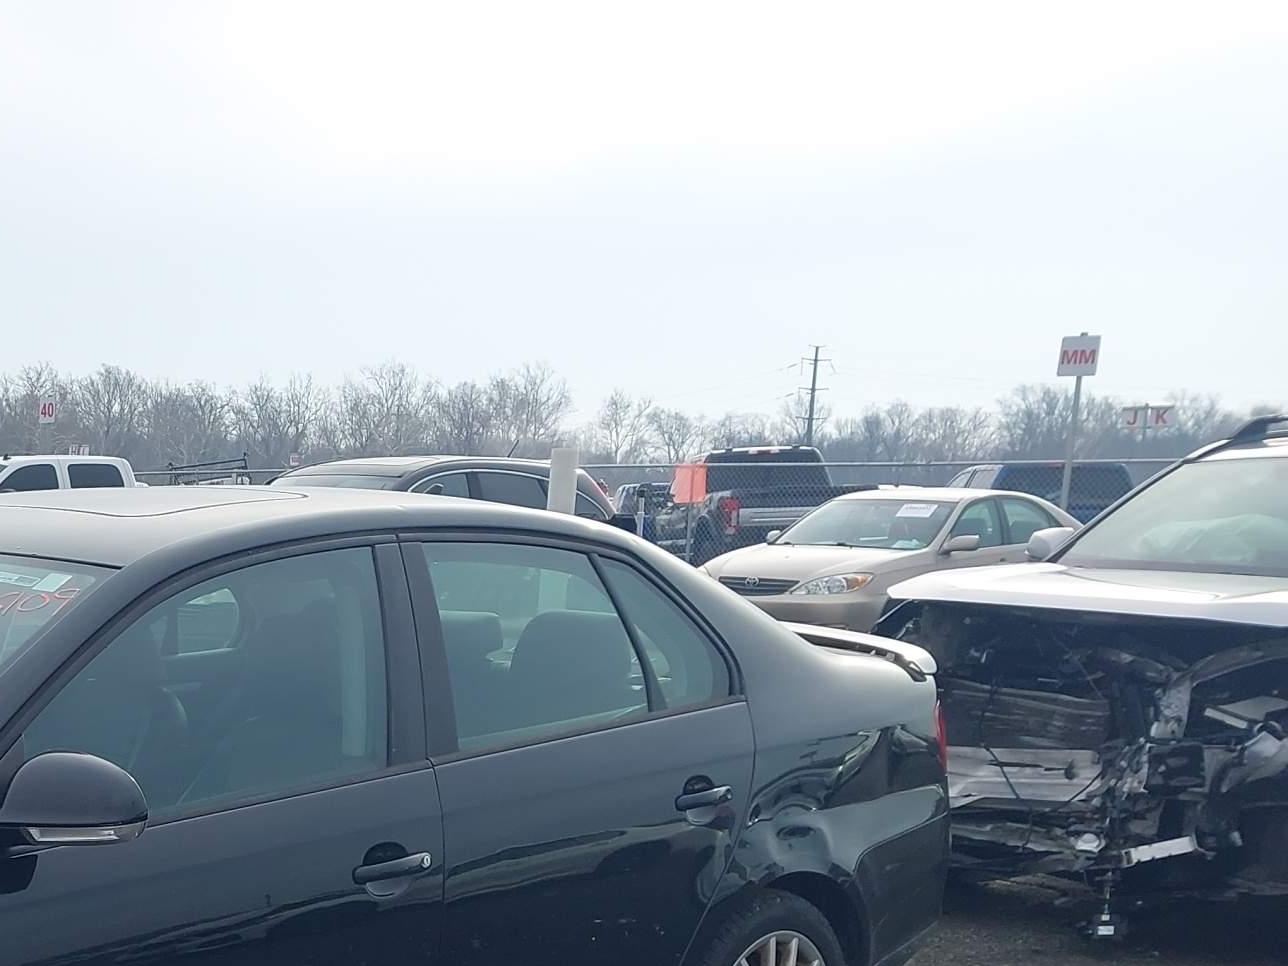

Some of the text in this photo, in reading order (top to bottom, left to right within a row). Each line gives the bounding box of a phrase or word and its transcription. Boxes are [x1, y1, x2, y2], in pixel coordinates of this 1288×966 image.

[1060, 348, 1097, 365] MM
[40, 402, 54, 418] 40
[1126, 407, 1170, 426] J K
